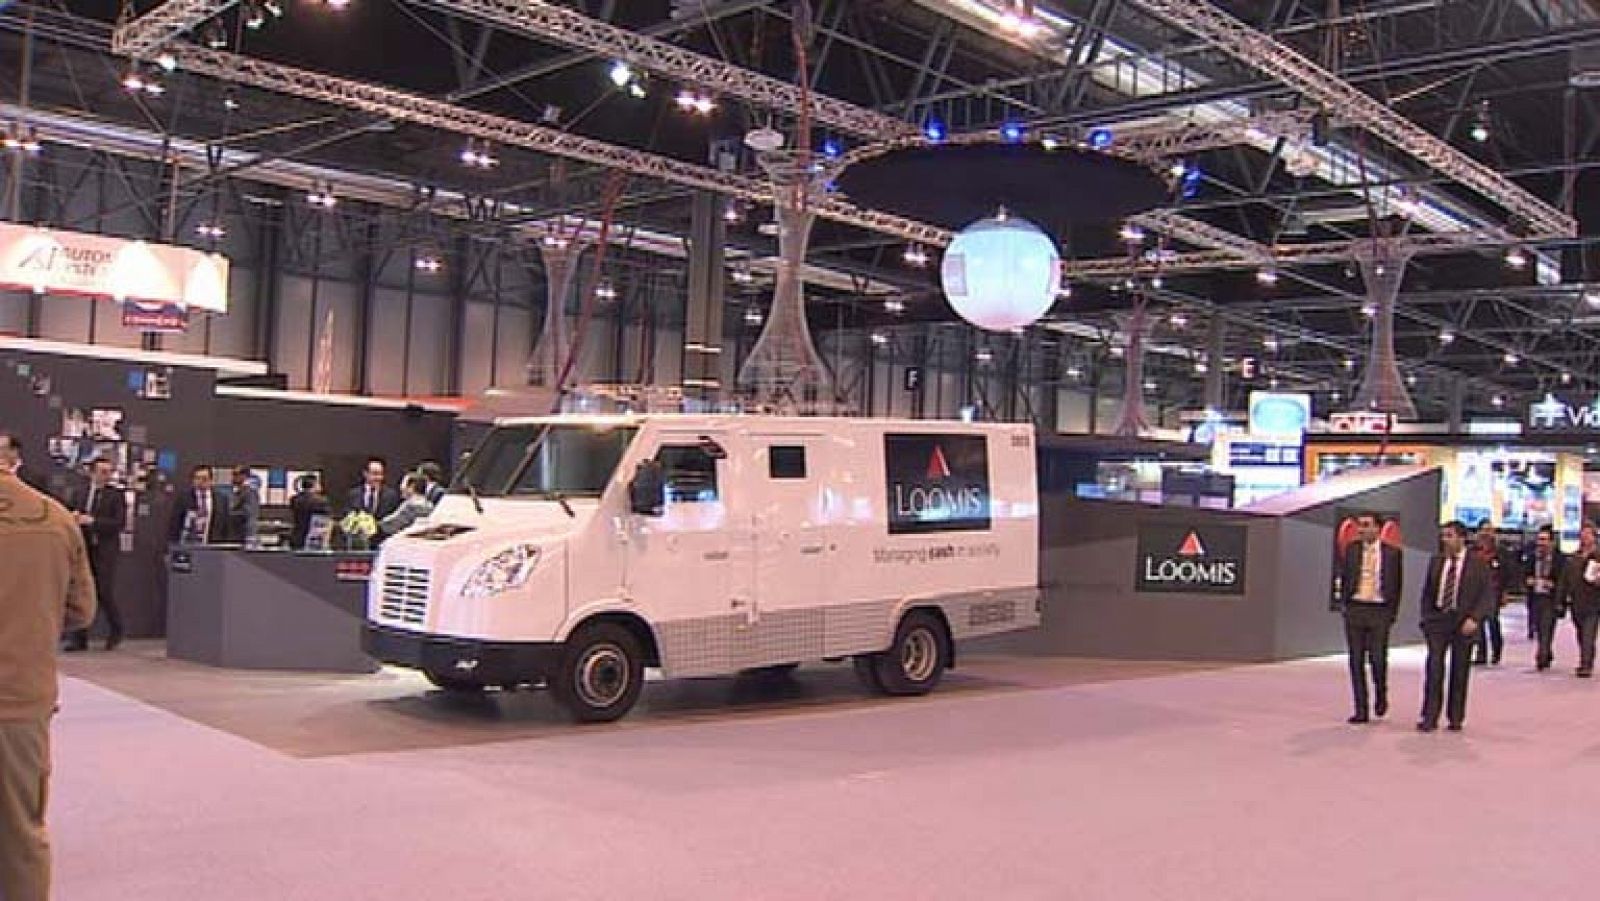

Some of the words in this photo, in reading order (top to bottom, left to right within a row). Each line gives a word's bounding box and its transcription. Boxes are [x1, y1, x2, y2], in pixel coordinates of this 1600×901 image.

[908, 370, 918, 387] F
[895, 483, 982, 517] LOOMIS
[1145, 555, 1236, 584] LOOMIS
